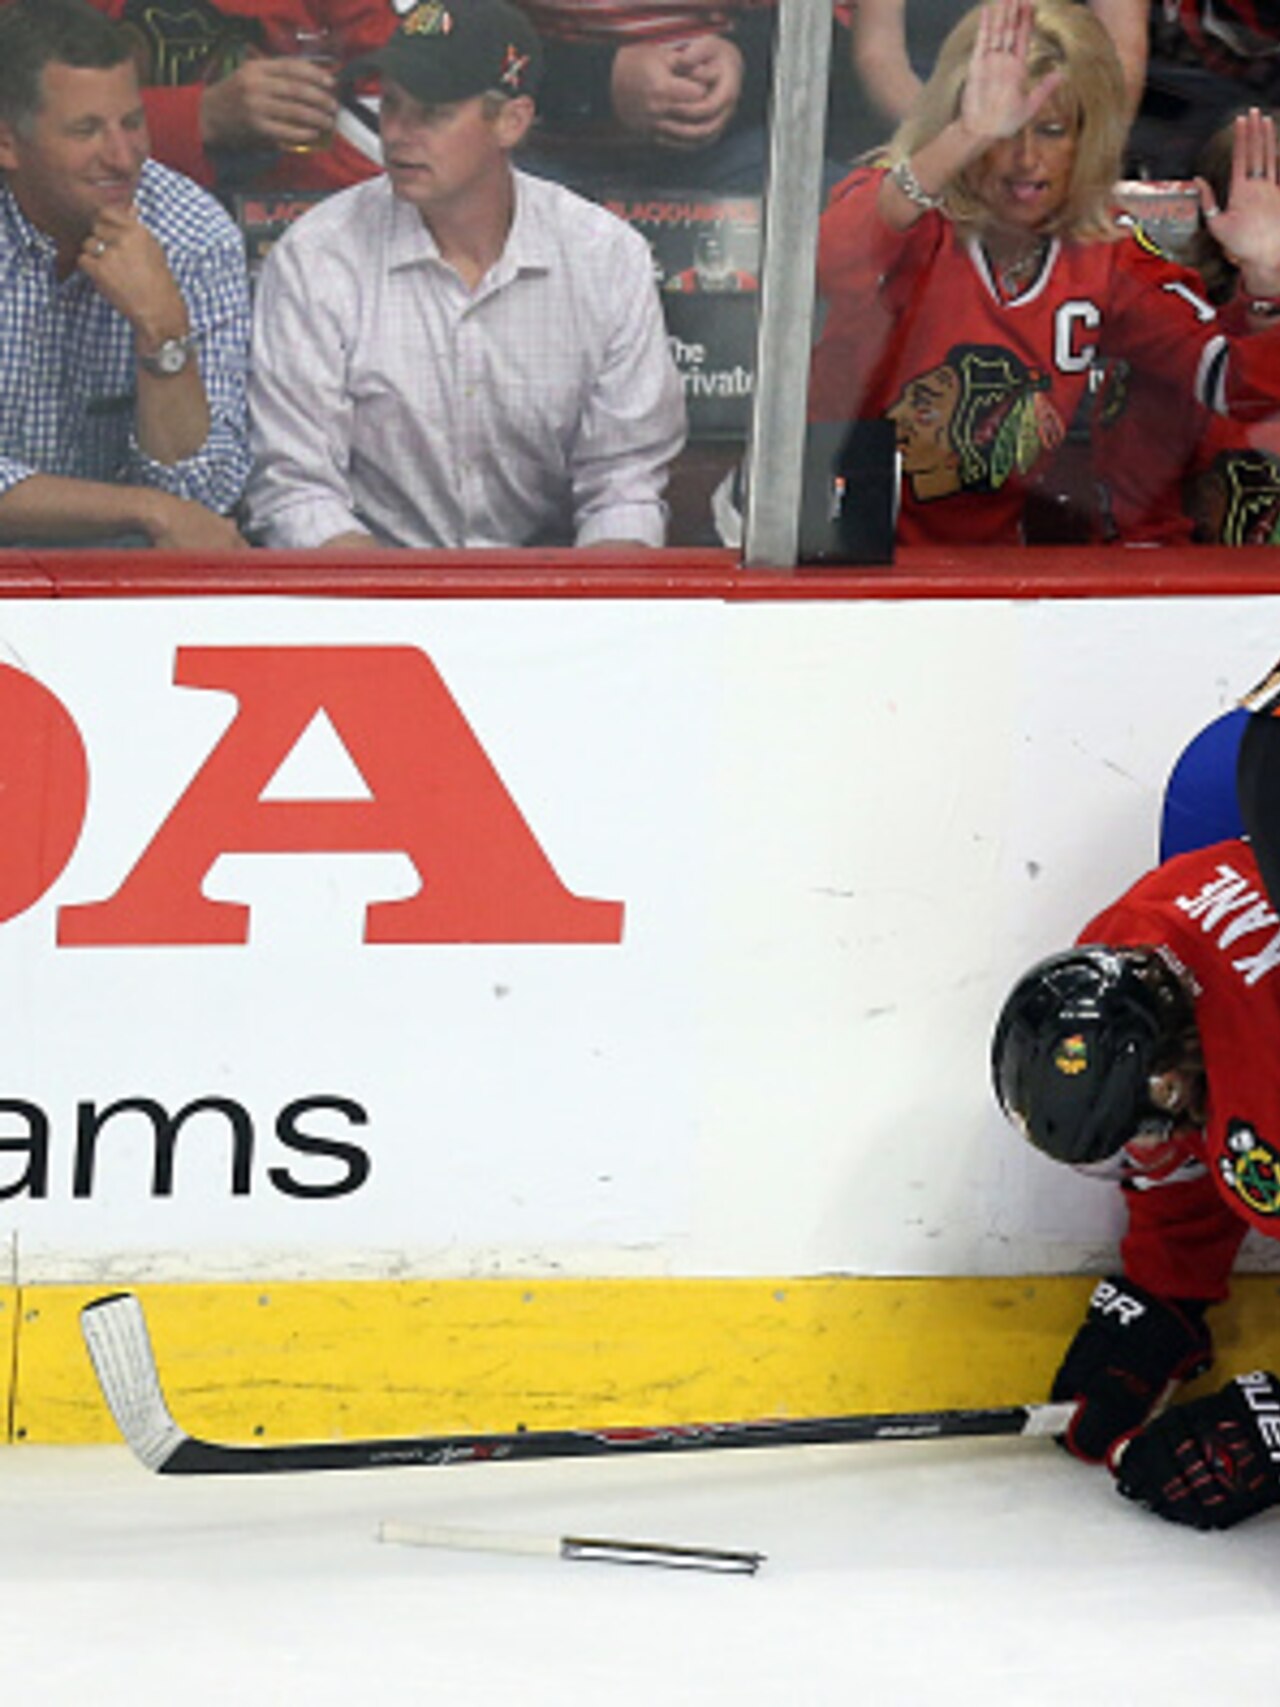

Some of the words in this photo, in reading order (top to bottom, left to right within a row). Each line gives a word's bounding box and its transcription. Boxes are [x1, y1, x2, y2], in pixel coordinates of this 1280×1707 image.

[244, 202, 314, 223] BLAC
[672, 339, 705, 363] he
[1054, 299, 1102, 374] C
[0, 644, 626, 948] A
[0, 1094, 372, 1199] ams
[1089, 1279, 1147, 1326] ER
